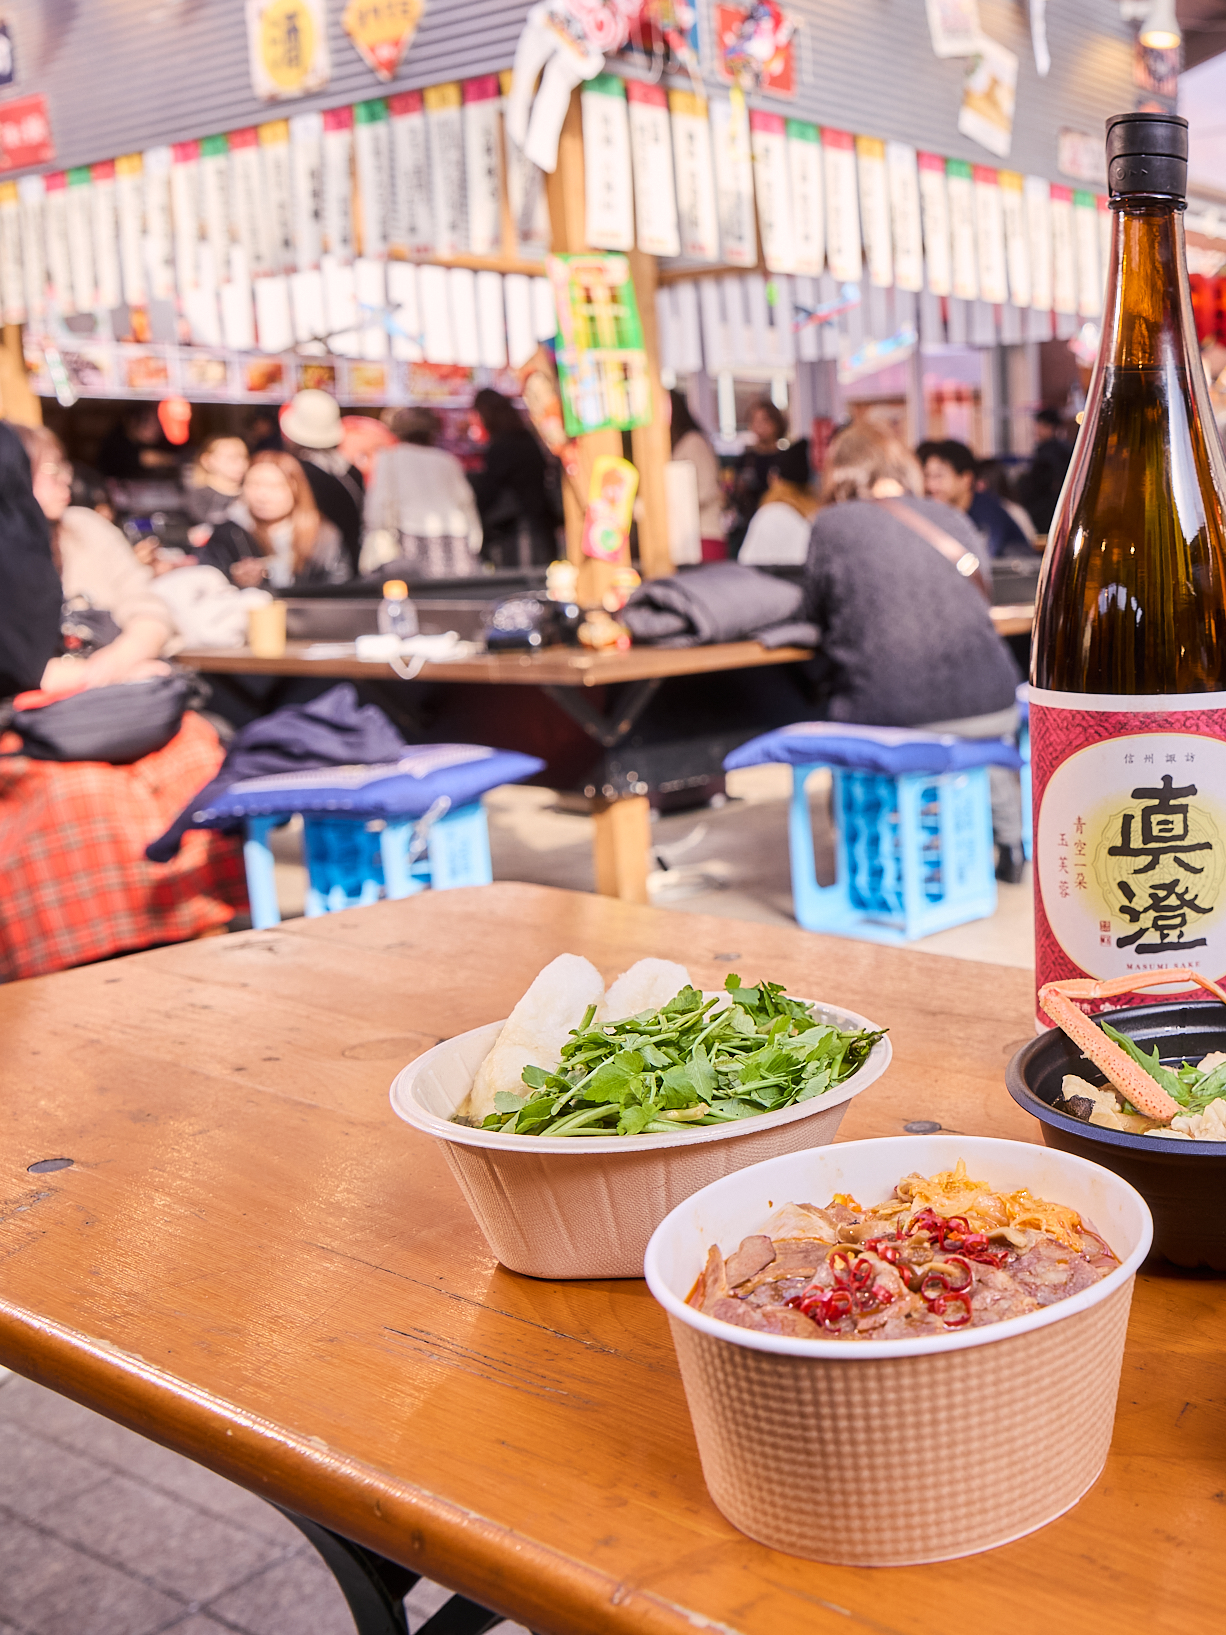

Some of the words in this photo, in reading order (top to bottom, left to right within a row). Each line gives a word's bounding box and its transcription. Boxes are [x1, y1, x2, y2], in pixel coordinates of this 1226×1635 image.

[1124, 753, 1196, 765] 信州諏訪
[1126, 962, 1169, 971] MASUMI
[1173, 960, 1201, 969] SAKE
